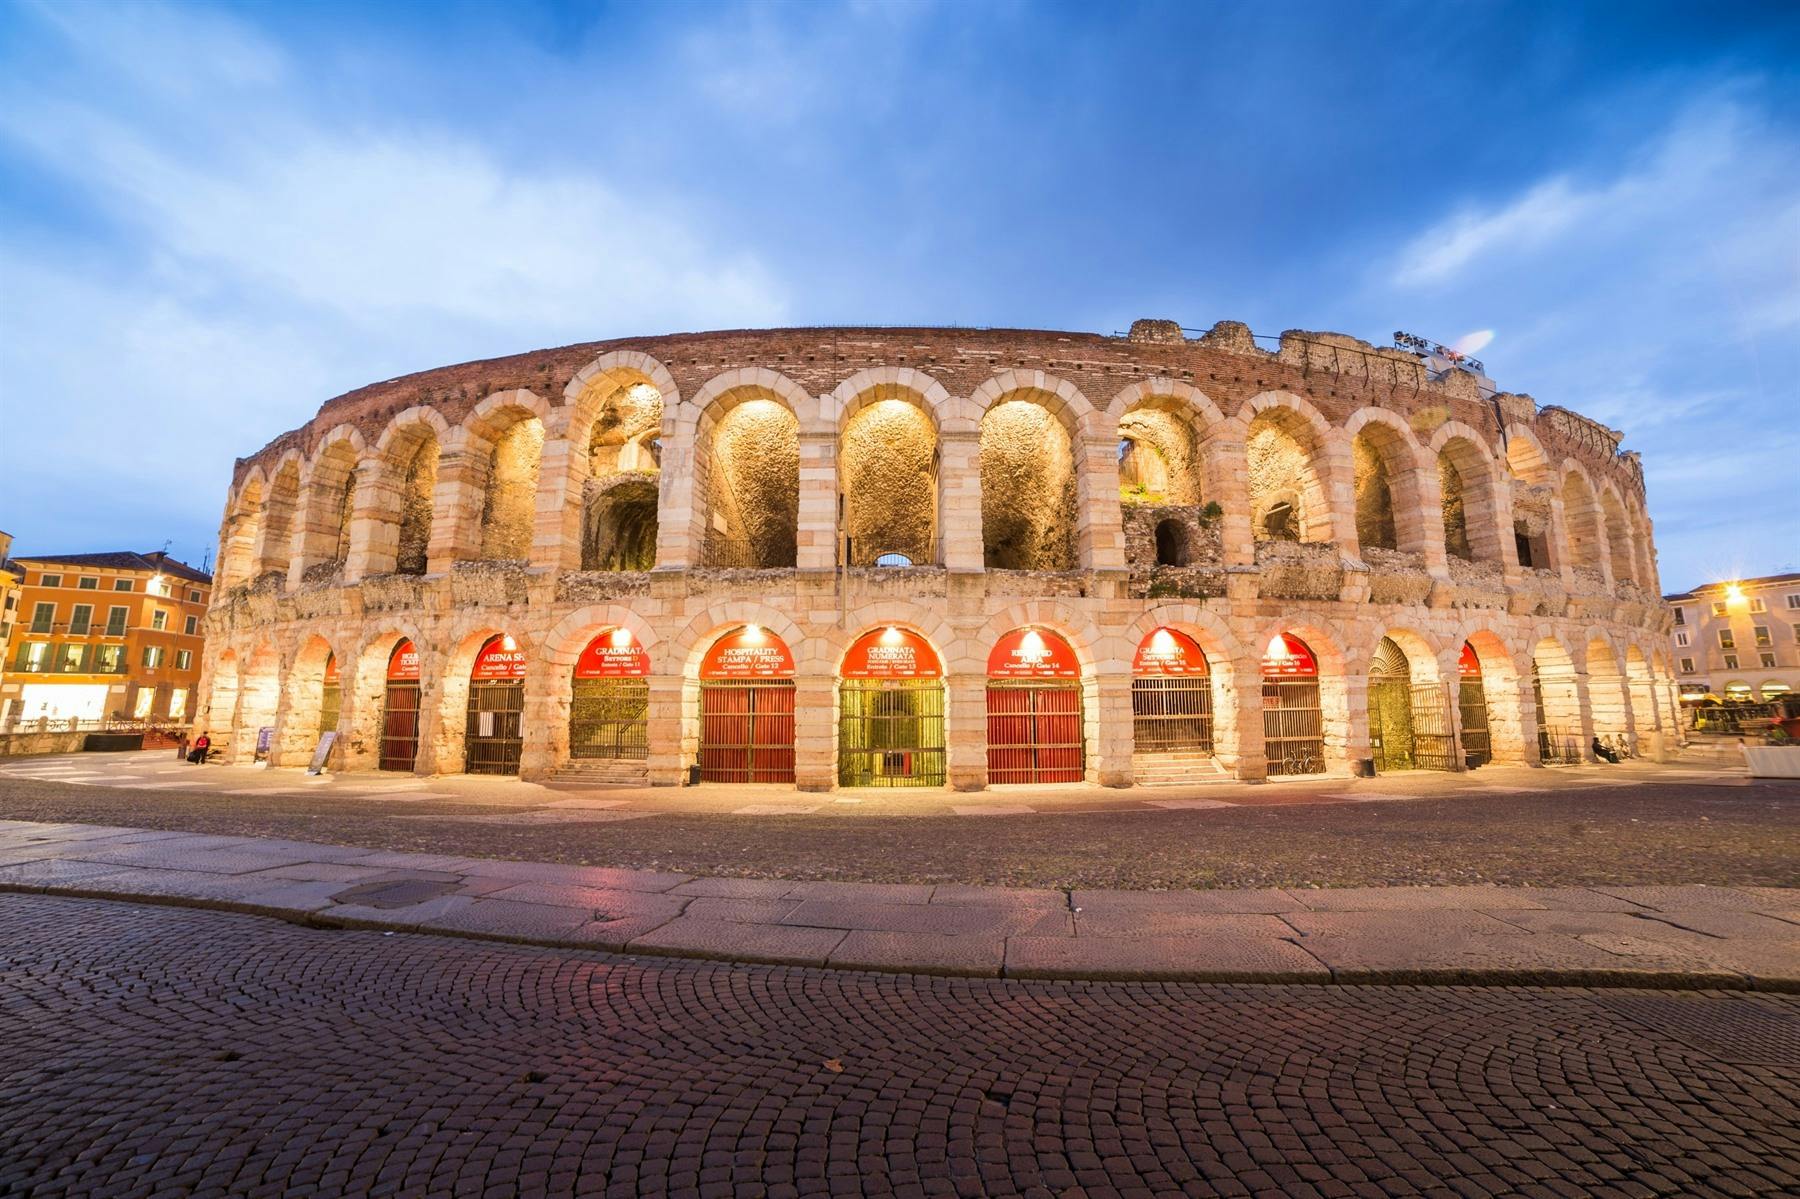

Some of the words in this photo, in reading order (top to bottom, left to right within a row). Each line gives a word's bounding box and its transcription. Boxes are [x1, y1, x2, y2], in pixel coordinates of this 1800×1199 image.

[595, 647, 647, 655] GRADINATA
[483, 653, 512, 662] ARENA
[754, 655, 759, 663] /
